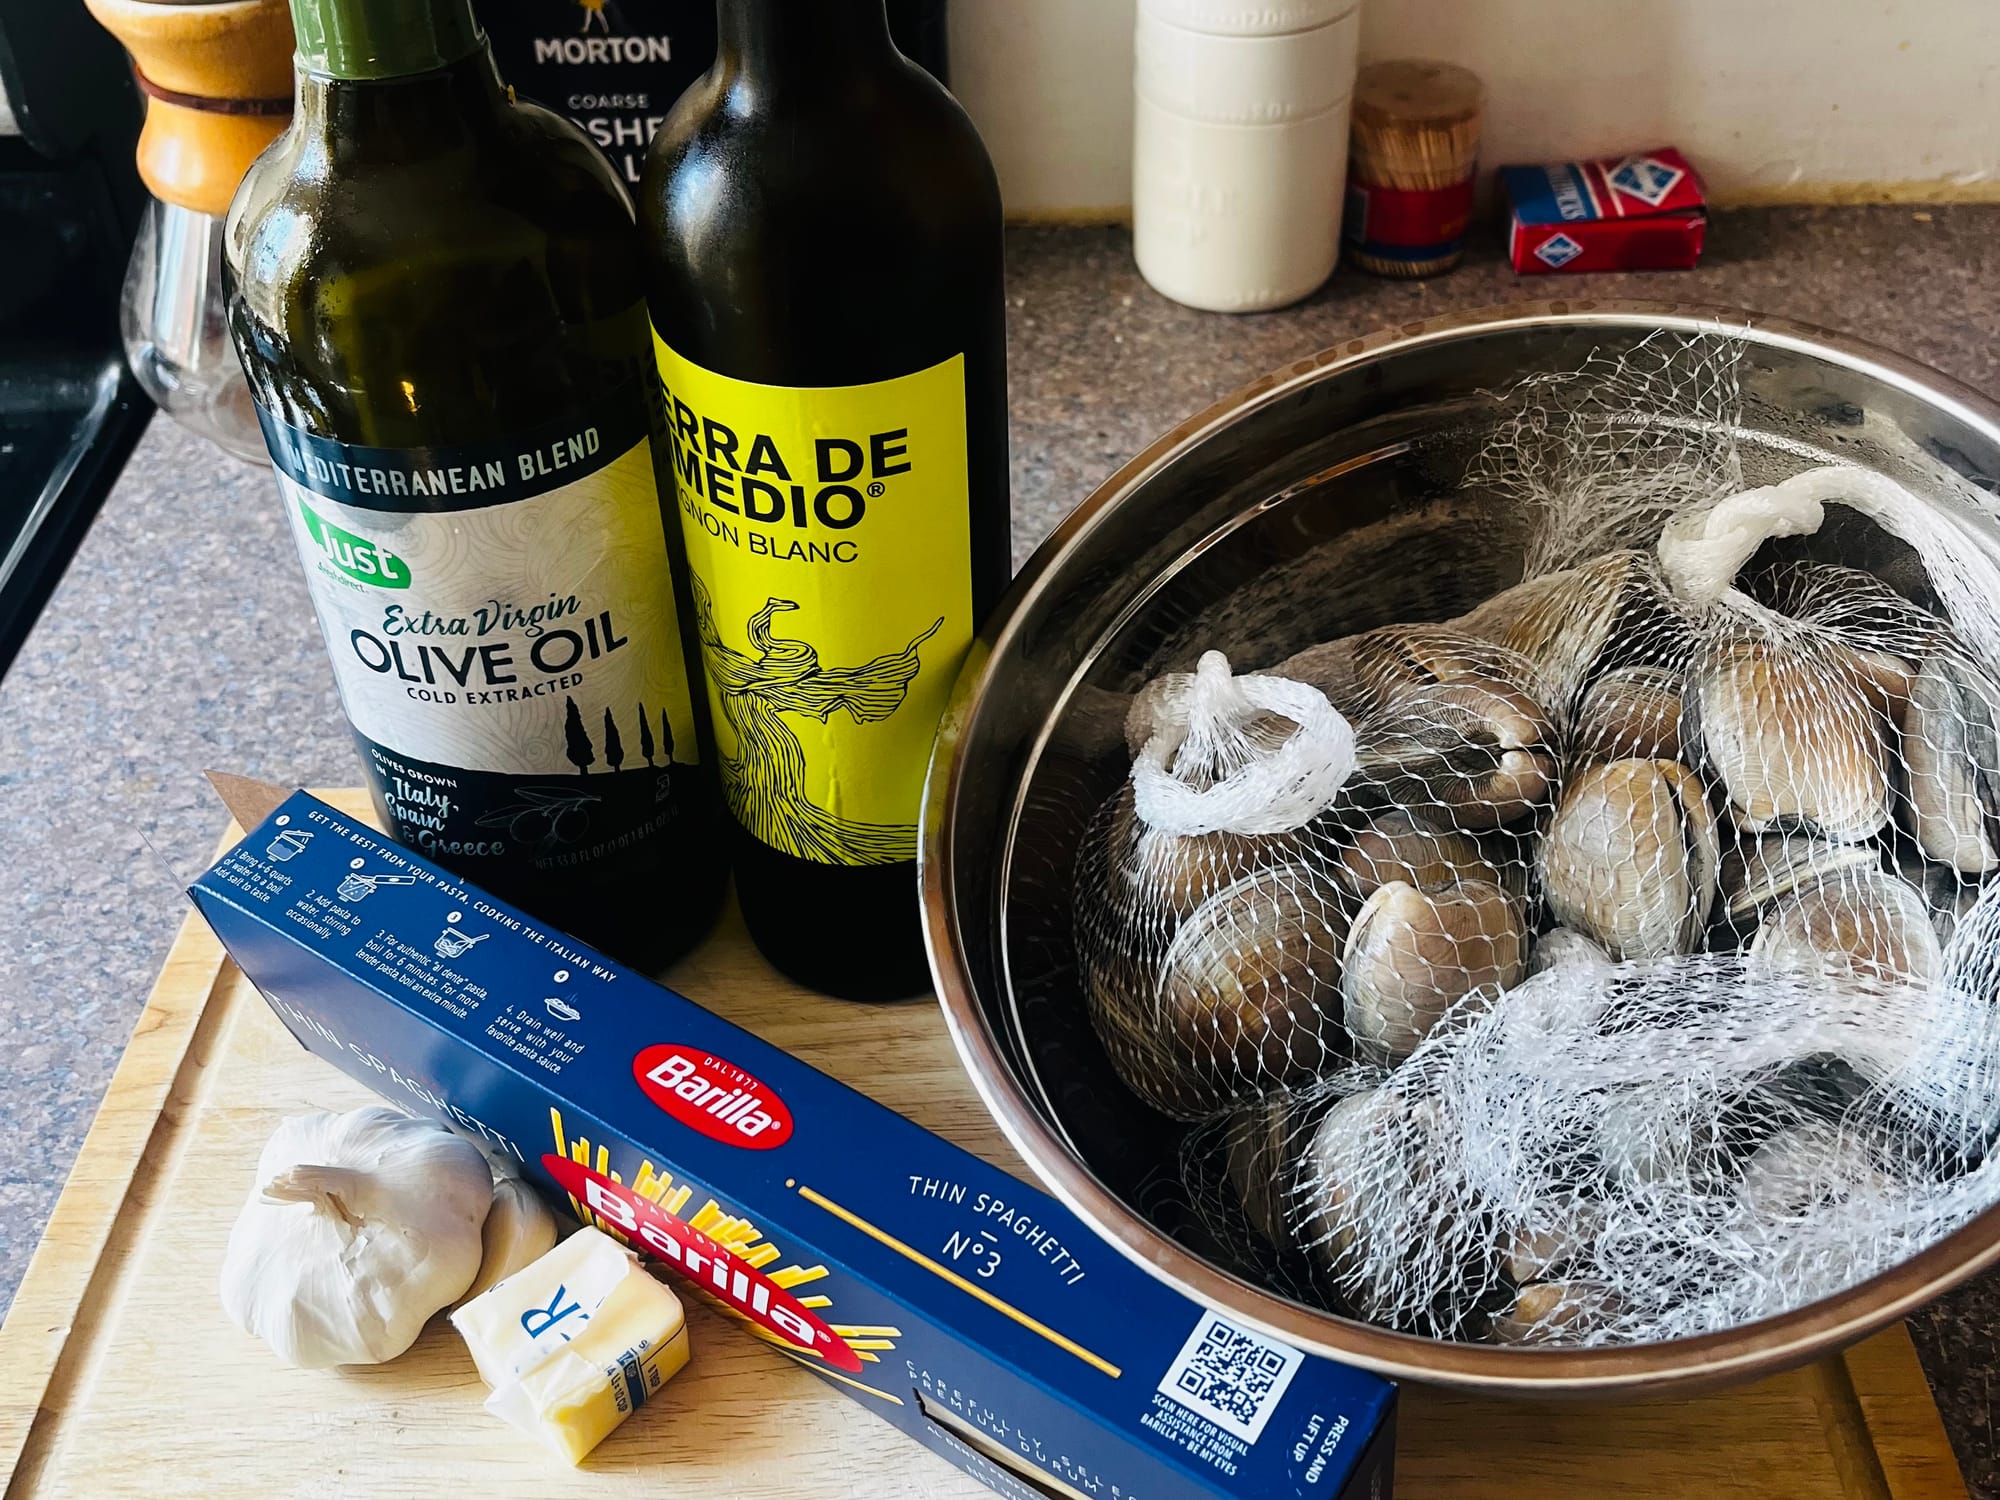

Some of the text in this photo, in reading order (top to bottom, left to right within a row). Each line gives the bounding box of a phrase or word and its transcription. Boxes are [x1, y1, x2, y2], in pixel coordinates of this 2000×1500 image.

[534, 36, 671, 64] MORTON
[567, 94, 649, 109] COARSE
[661, 384, 912, 483] ERRA DE
[290, 426, 601, 496] MEDITERRANEAN BLEND
[317, 523, 399, 579] Just
[748, 532, 859, 563] BLANC
[383, 592, 582, 637] Extra Virgin
[351, 610, 628, 688] OLIVE OIL
[407, 673, 583, 705] COLD EXTRACTED
[371, 749, 457, 788] OLIVES GROWN
[375, 763, 387, 776] IN
[384, 792, 445, 831] Spain
[418, 830, 504, 858] Greece
[213, 866, 270, 903] Add salt to taste.
[223, 858, 236, 866] of
[232, 863, 253, 877] water
[251, 872, 261, 881] to
[239, 851, 259, 868] Bring
[257, 861, 273, 873] 4-6
[269, 870, 293, 886] quarts
[296, 900, 351, 936] water, stirring
[308, 810, 617, 983] GET THE BEST FROM YOUR PASTA, COOKING THE ITALIAN WAY
[314, 895, 333, 908] Add
[328, 904, 351, 919] pasta
[350, 915, 361, 925] to
[286, 909, 332, 939] occasionally.
[355, 948, 468, 1020] tender pasta, boil an extra minute.
[365, 939, 480, 1010] boil for 6 minutes. For more
[384, 934, 399, 946] For
[397, 943, 431, 967] authentic
[463, 982, 488, 1001] pasta,
[485, 1024, 561, 1075] favorite pasta sauce.
[495, 1015, 574, 1063] serve with your
[516, 1010, 542, 1030] Drain
[543, 1026, 566, 1042] well
[563, 1039, 585, 1054] and
[265, 989, 525, 1163] THIN SPAGHETTI
[704, 1056, 759, 1091] DAL 1877
[633, 1195, 731, 1260] DAL 1877
[909, 1175, 1085, 1285] THIN SPAGHETTI
[906, 1360, 1042, 1449] CAREFULLY
[1152, 1394, 1248, 1456] SCAN HERE FOR VISUAL
[909, 1370, 1097, 1493] PREMIUM DURUM
[1140, 1413, 1178, 1441] BARILLA
[1186, 1440, 1201, 1454] BE
[1199, 1447, 1216, 1462] MY
[1214, 1457, 1238, 1476] EYES
[1156, 1410, 1234, 1460] ASSISTANCE FROM
[1293, 1414, 1325, 1462] LIFT UP
[1305, 1414, 1350, 1483] PRESS AND
